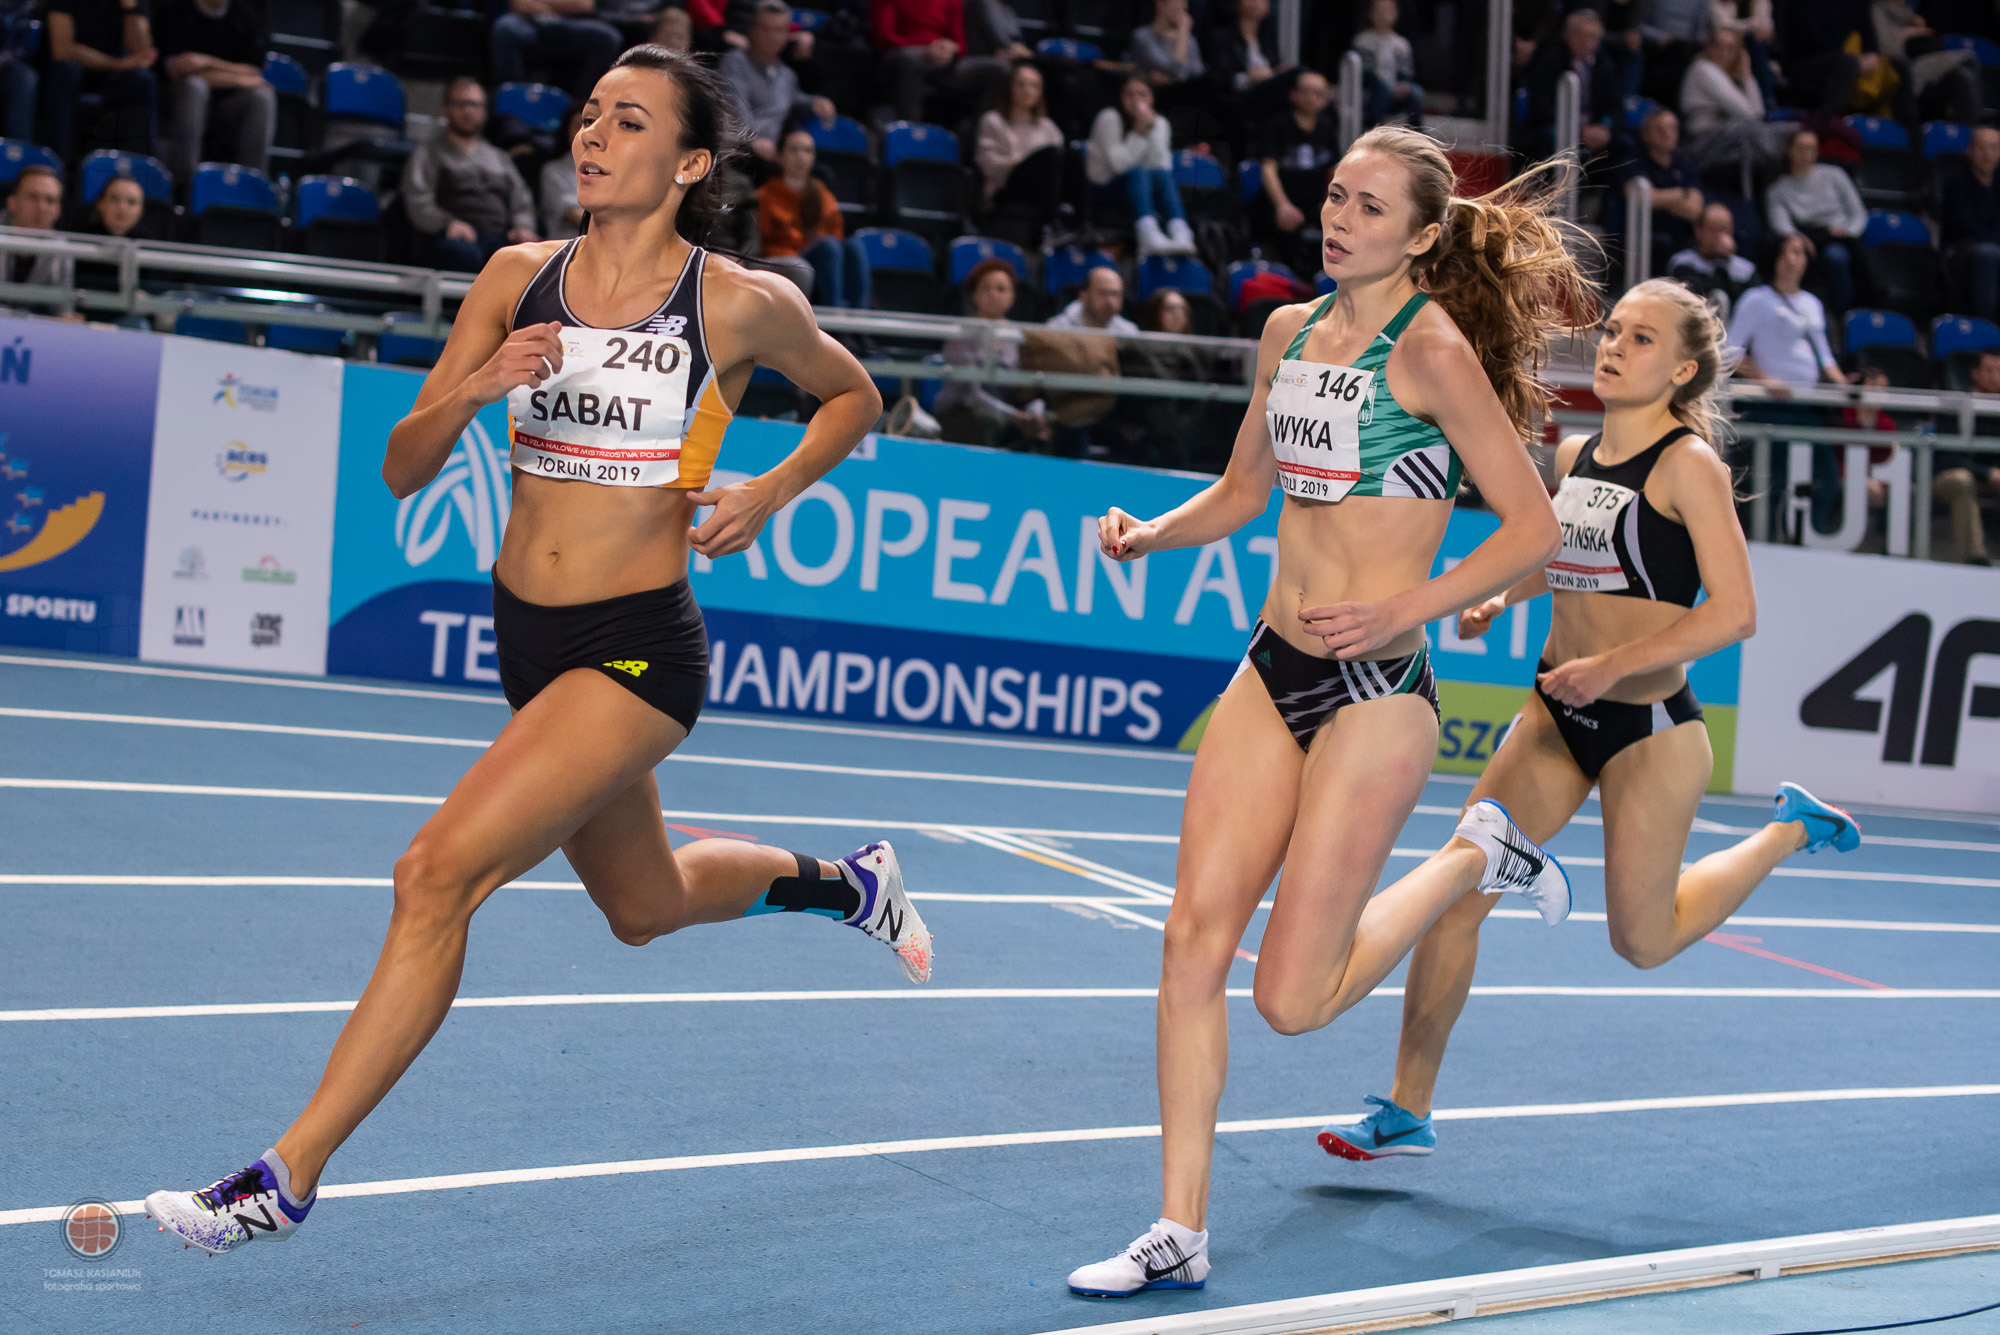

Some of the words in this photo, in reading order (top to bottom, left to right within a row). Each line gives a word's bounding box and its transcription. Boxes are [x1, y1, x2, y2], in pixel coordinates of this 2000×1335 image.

[602, 337, 681, 374] 240
[1315, 370, 1363, 401] 146
[530, 390, 651, 431] SABAT
[1274, 413, 1333, 451] WYKA
[529, 438, 545, 449] PZLA
[545, 443, 579, 454] HALOWE
[579, 448, 638, 459] MISTRZOSTWA
[639, 451, 670, 459] POLSKI
[537, 455, 591, 478] TORUŃ
[597, 465, 641, 482] 2019
[1301, 480, 1328, 497] 2019
[1587, 486, 1625, 510] 375
[694, 468, 1147, 620] ROPEAN
[1560, 520, 1609, 553] ZYŃSKA
[1576, 576, 1599, 589] 2019
[420, 610, 501, 683] TE
[709, 640, 1163, 742] HAMPIONSHIPS
